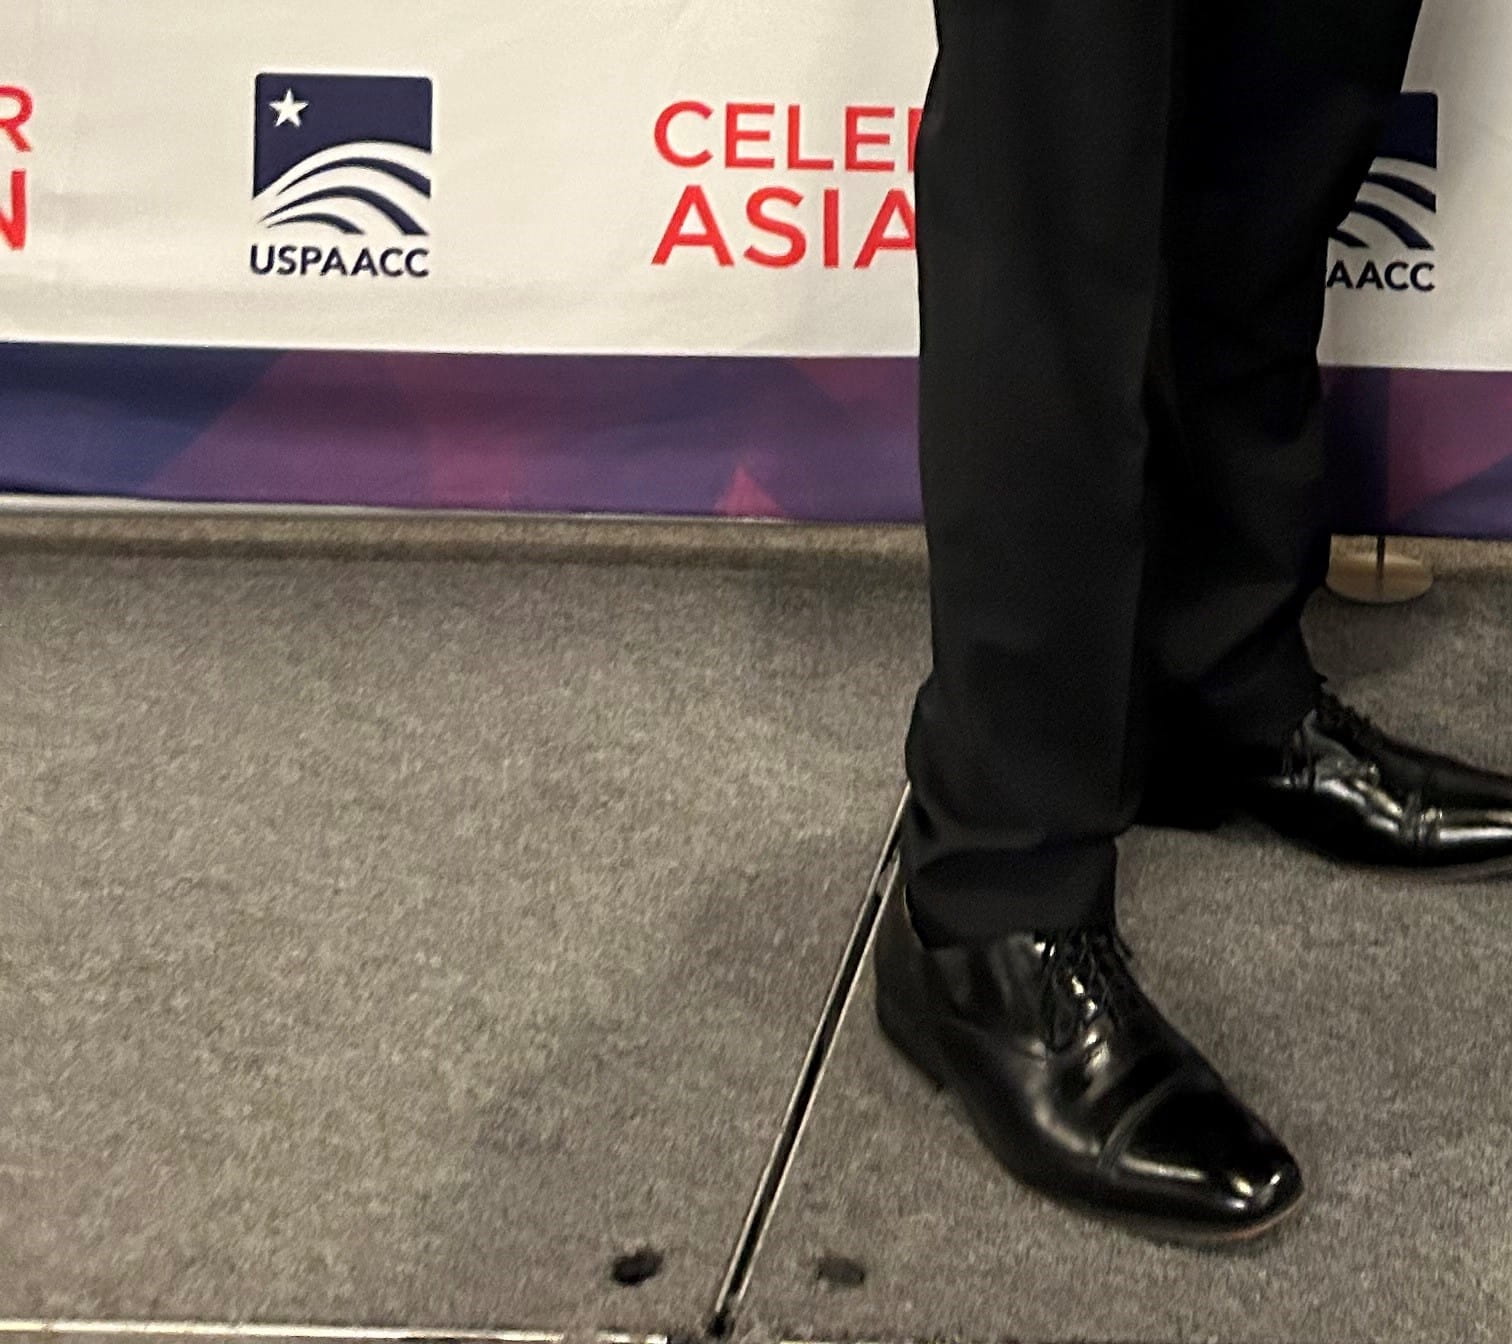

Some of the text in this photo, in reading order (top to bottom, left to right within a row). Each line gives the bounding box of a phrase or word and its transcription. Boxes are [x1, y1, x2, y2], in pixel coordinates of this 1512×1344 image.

[653, 100, 923, 173] CELE
[249, 244, 430, 278] USPAACC
[1324, 260, 1437, 293] AACC
